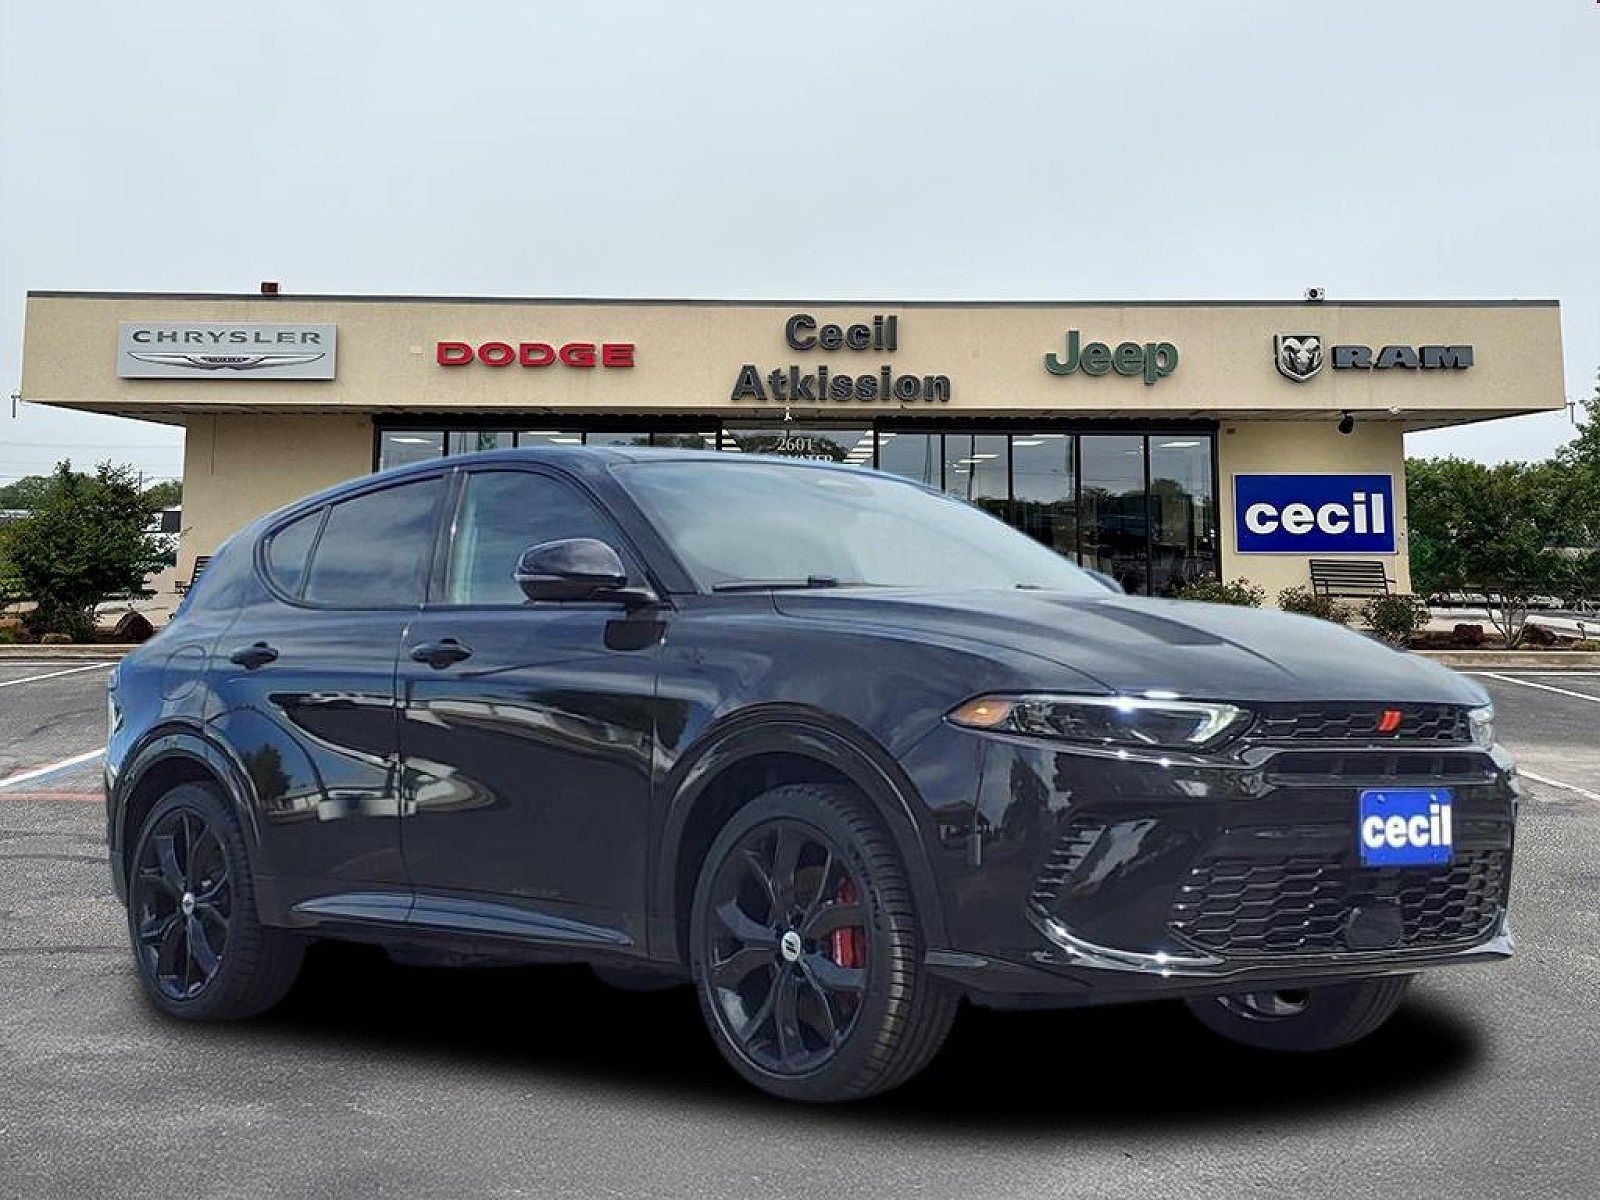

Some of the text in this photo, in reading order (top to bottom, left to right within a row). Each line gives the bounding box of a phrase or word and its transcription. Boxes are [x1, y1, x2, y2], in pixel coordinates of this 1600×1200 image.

[132, 329, 322, 345] CHRYSLER
[785, 314, 898, 352] Cecil
[436, 341, 635, 368] DODGE
[1045, 330, 1179, 385] Jeep
[1333, 344, 1473, 370] RAM
[732, 364, 951, 402] Atkission
[1244, 492, 1386, 535] cecil
[1362, 803, 1453, 849] cecil
